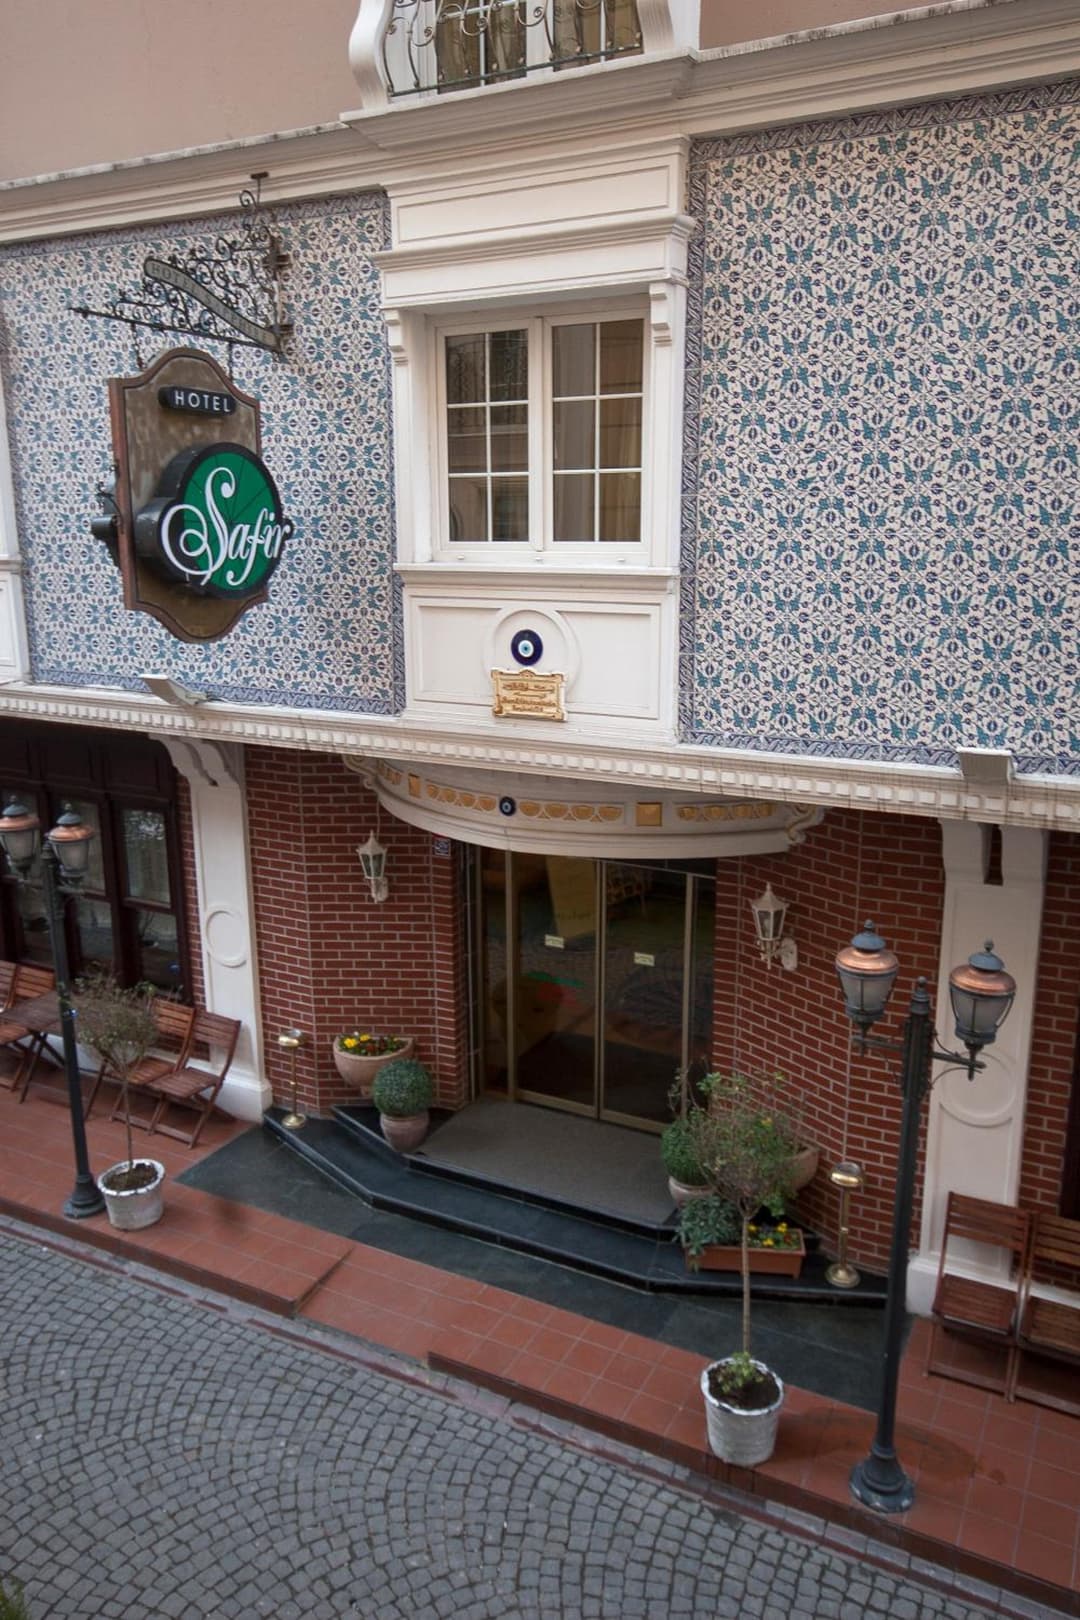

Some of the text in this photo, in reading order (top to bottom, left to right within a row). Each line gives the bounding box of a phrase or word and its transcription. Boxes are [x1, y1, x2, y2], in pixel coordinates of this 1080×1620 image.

[152, 262, 198, 296] HOTEL
[174, 389, 232, 413] HOTEL
[161, 466, 292, 587] Safir
